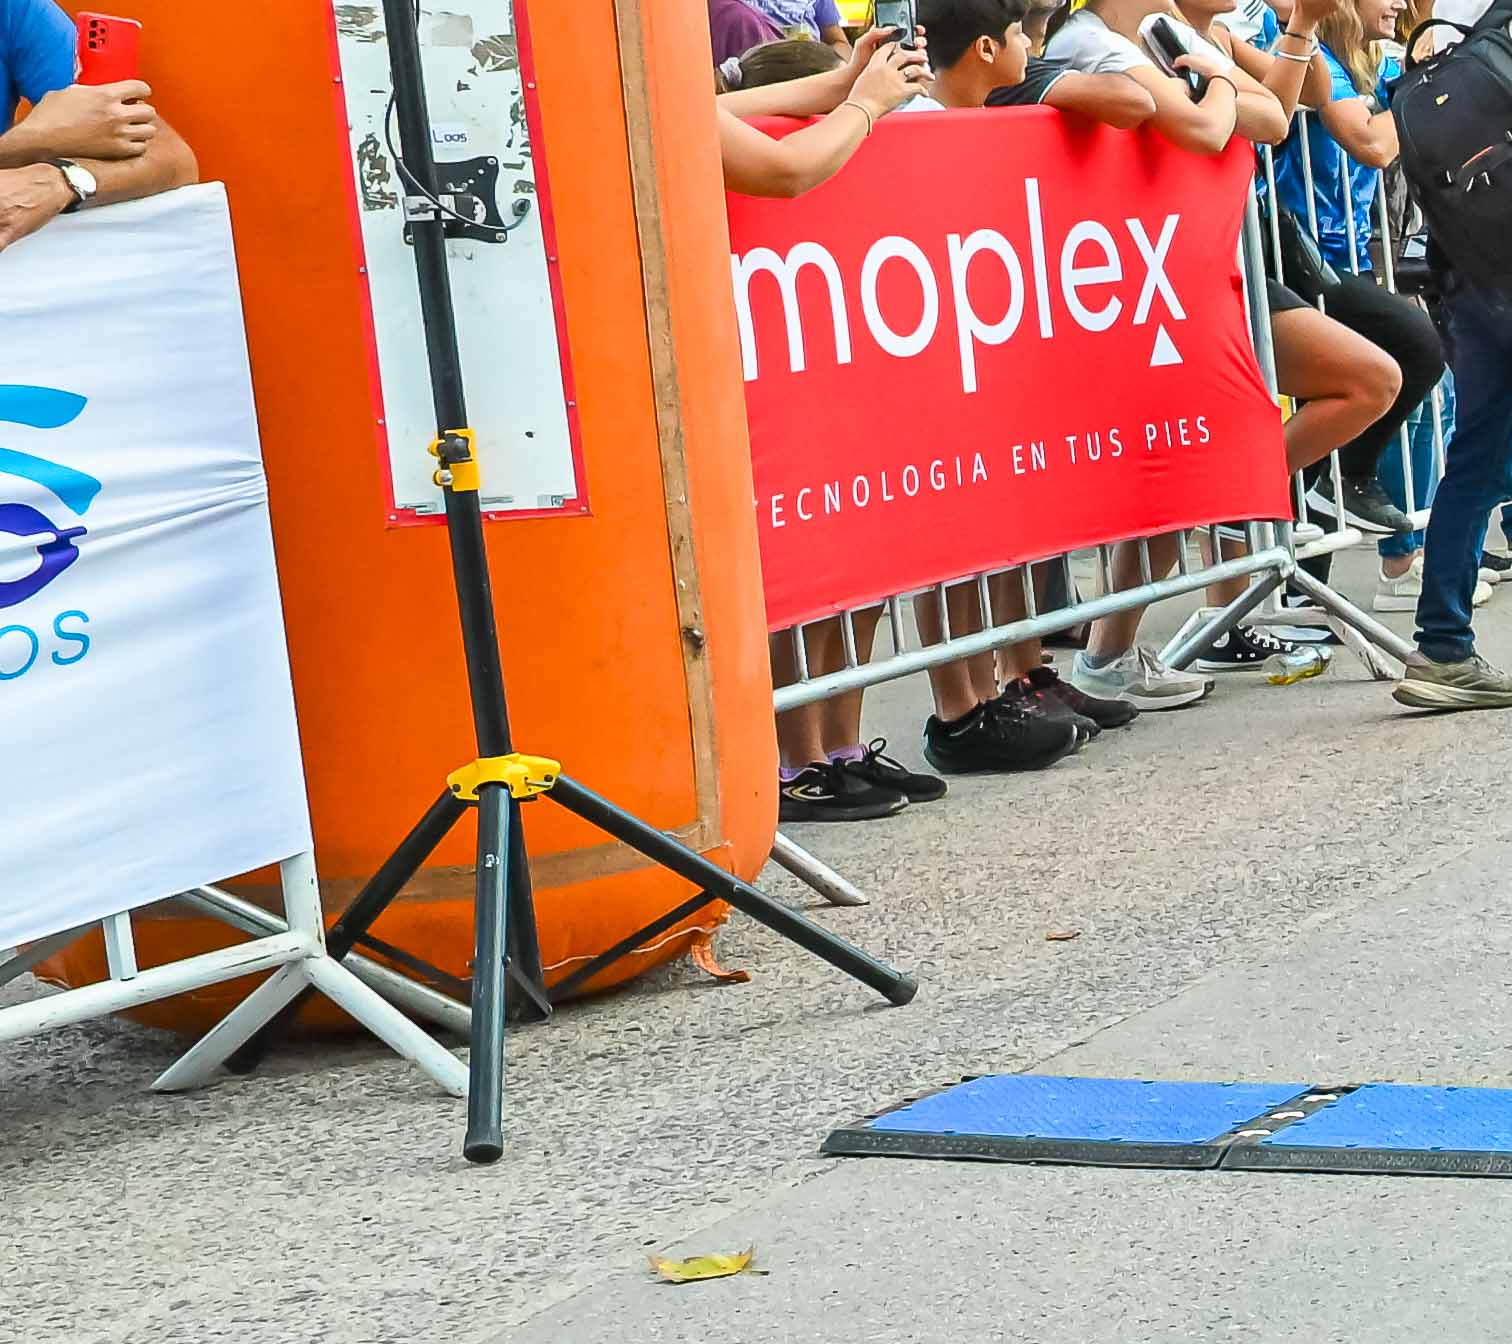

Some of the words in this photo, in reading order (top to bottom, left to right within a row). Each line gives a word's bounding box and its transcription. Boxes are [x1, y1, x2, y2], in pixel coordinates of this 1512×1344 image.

[731, 178, 1186, 392] moplex
[752, 453, 988, 528] ECNOLOGIA
[1013, 440, 1047, 476] EN
[1066, 428, 1124, 465] TUS
[1145, 416, 1213, 450] PIES
